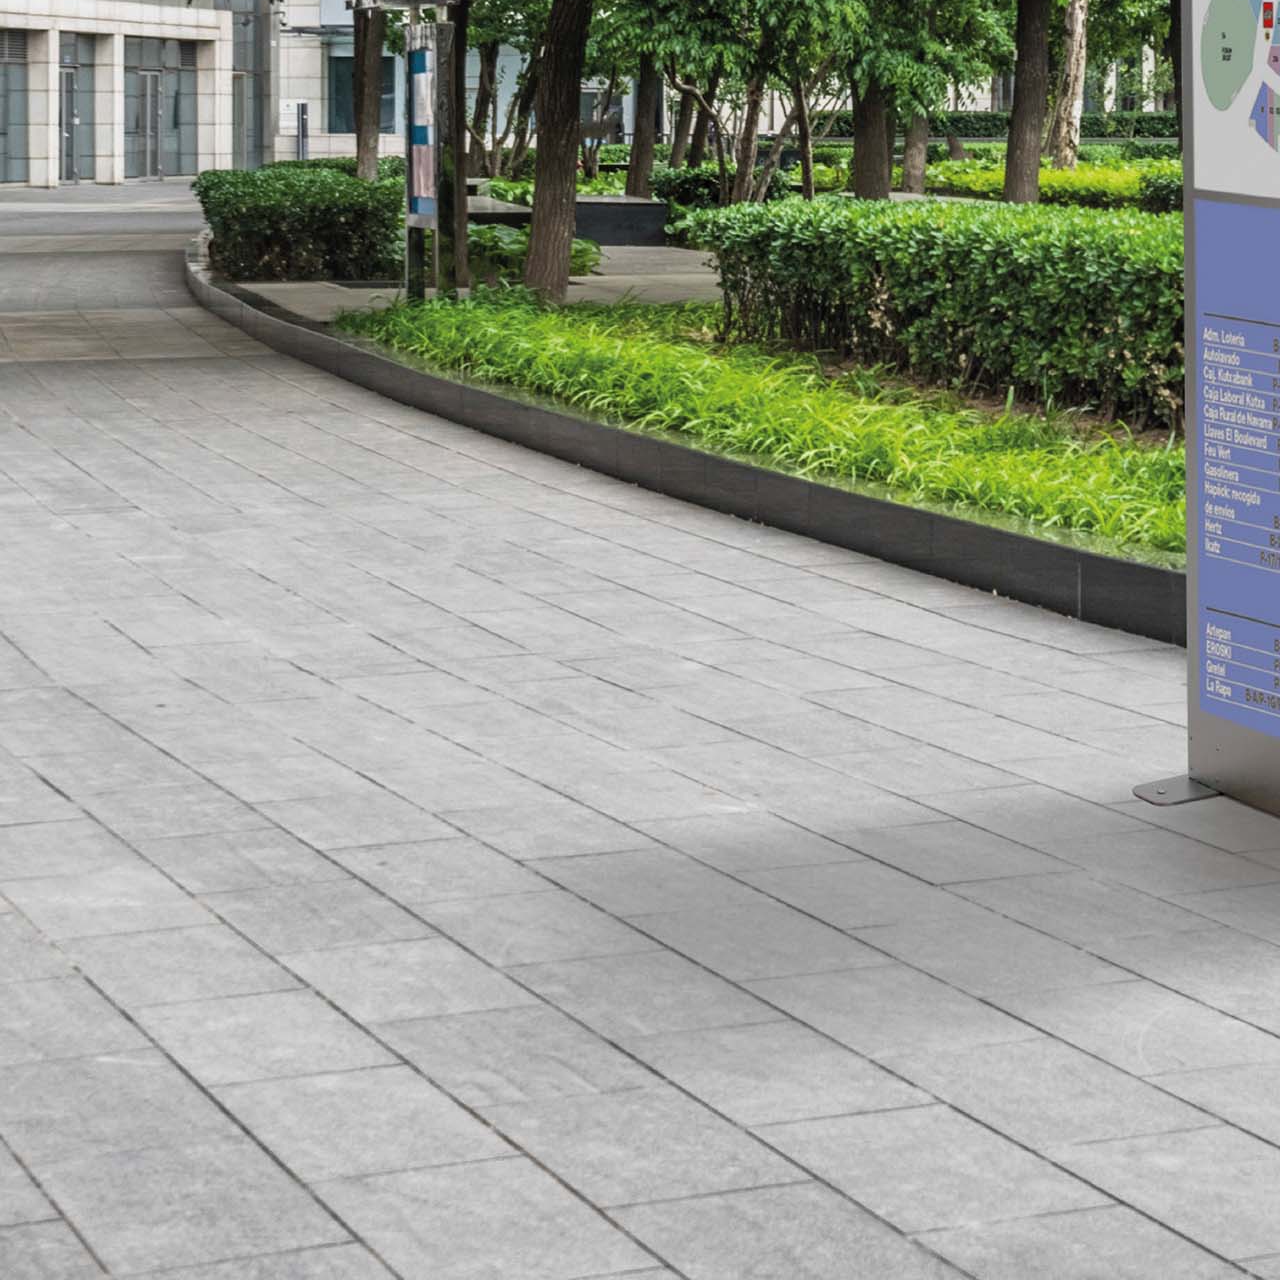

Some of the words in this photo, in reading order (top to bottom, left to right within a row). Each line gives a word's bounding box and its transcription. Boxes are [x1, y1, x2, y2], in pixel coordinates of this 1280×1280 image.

[1203, 348, 1240, 366] Autolavado
[1204, 386, 1218, 401] Caja
[1220, 389, 1245, 405] Laboral
[1204, 404, 1218, 420] Caja
[1220, 407, 1236, 422] Rural
[1237, 411, 1246, 424] de
[1234, 430, 1267, 449] Boulevard
[1204, 442, 1216, 457] Feu
[1204, 462, 1239, 482] Gasolinera
[1232, 490, 1261, 506] recogida
[1205, 501, 1214, 514] de
[1205, 520, 1222, 535] Hertz
